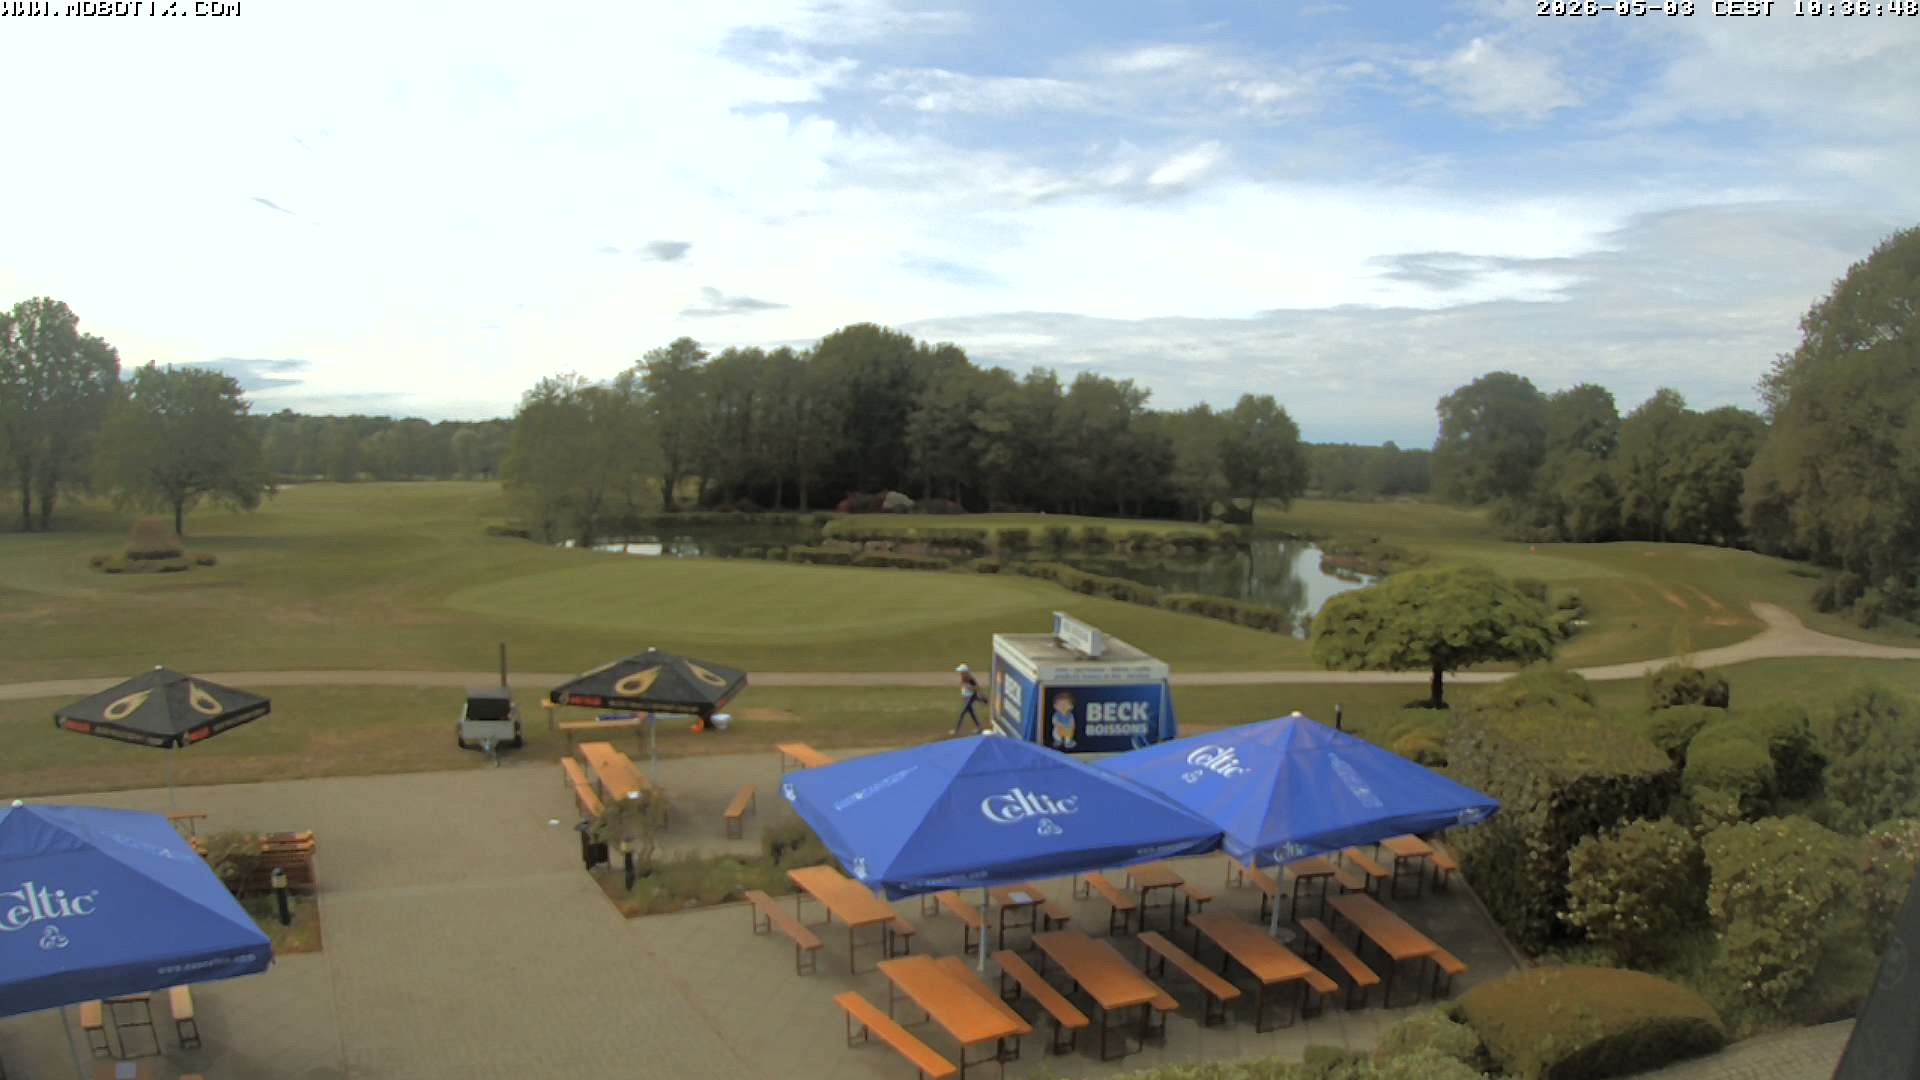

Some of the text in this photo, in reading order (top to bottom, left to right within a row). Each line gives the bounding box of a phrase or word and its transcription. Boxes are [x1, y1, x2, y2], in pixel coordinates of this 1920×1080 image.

[1086, 701, 1149, 721] BECK
[1085, 723, 1149, 737] BOISSONS
[1187, 744, 1244, 778] Celtic
[981, 787, 1078, 824] Celtic
